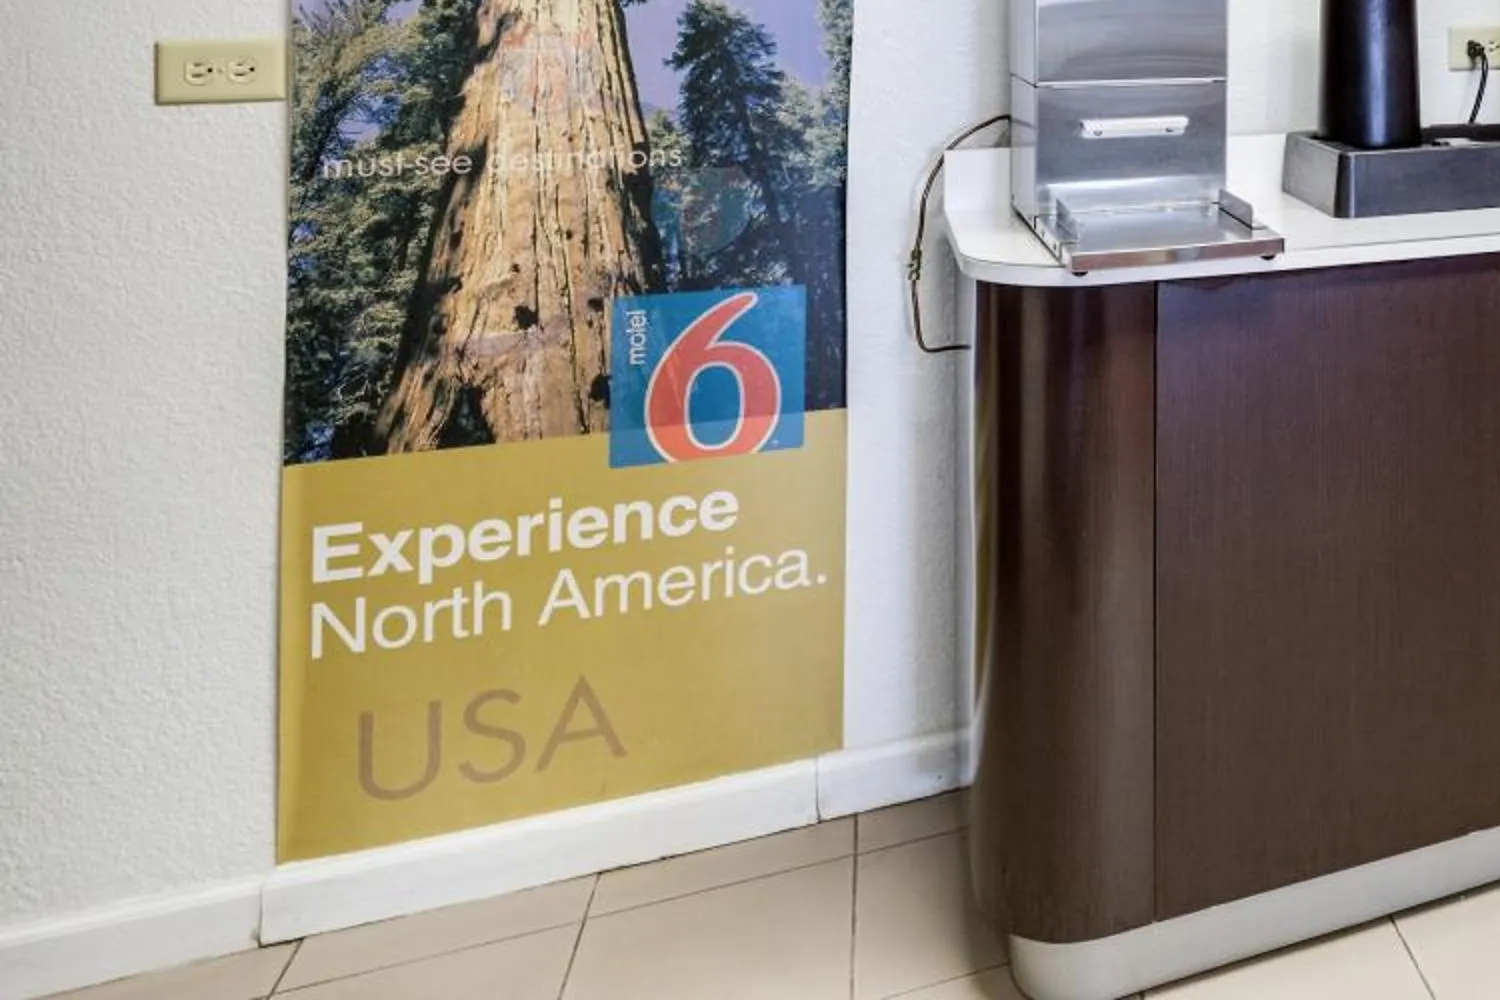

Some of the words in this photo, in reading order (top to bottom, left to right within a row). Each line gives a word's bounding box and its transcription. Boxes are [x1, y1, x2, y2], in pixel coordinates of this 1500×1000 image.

[321, 150, 473, 179] must-see
[628, 309, 646, 366] motel
[644, 290, 782, 464] 6
[311, 489, 740, 586] Experience
[311, 579, 512, 659] North
[537, 545, 828, 626] America.
[357, 673, 627, 801] USA
